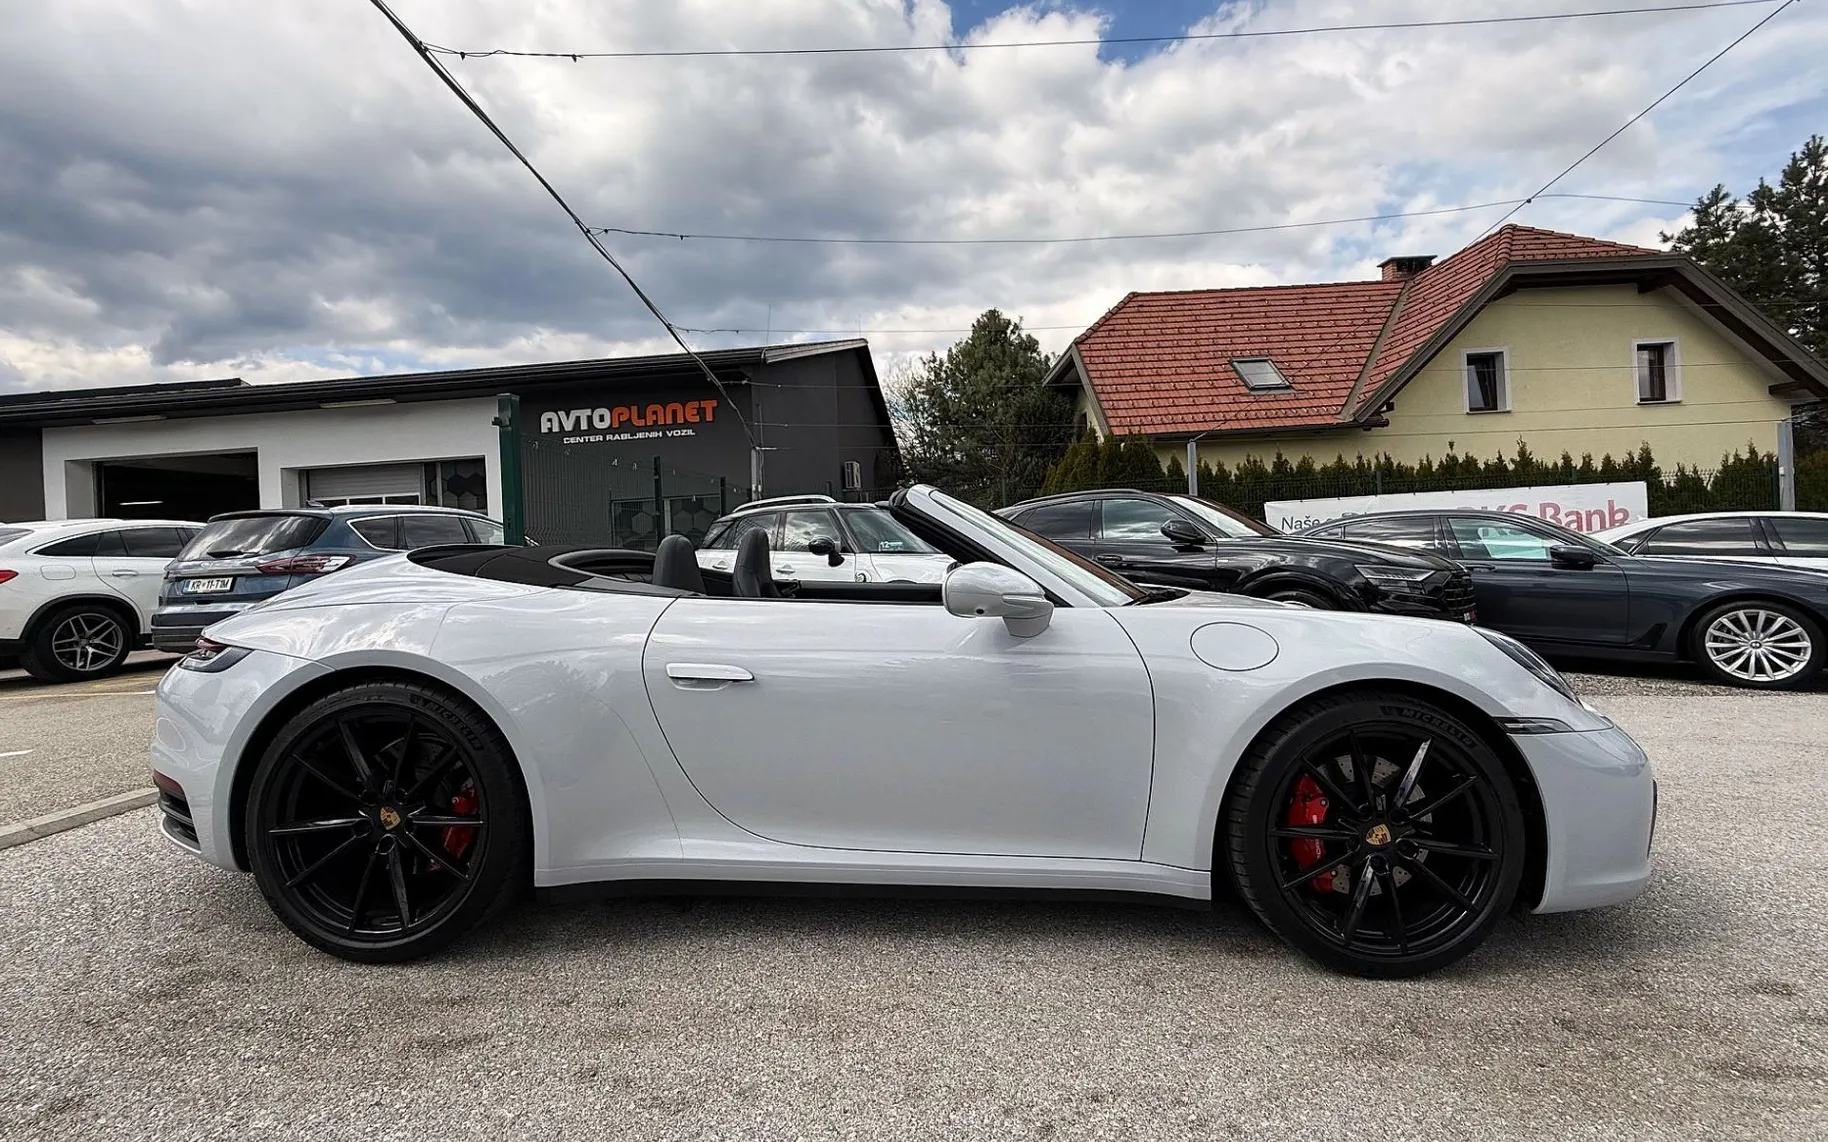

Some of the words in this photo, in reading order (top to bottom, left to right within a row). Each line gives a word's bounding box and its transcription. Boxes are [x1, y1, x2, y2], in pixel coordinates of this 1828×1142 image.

[540, 400, 718, 433] AVTOPLANET
[563, 435, 603, 444] CENTER
[606, 430, 662, 441] RABLJENIH
[666, 429, 695, 437] VOZIL
[1281, 515, 1321, 531] Naše
[1539, 500, 1630, 532] Bank
